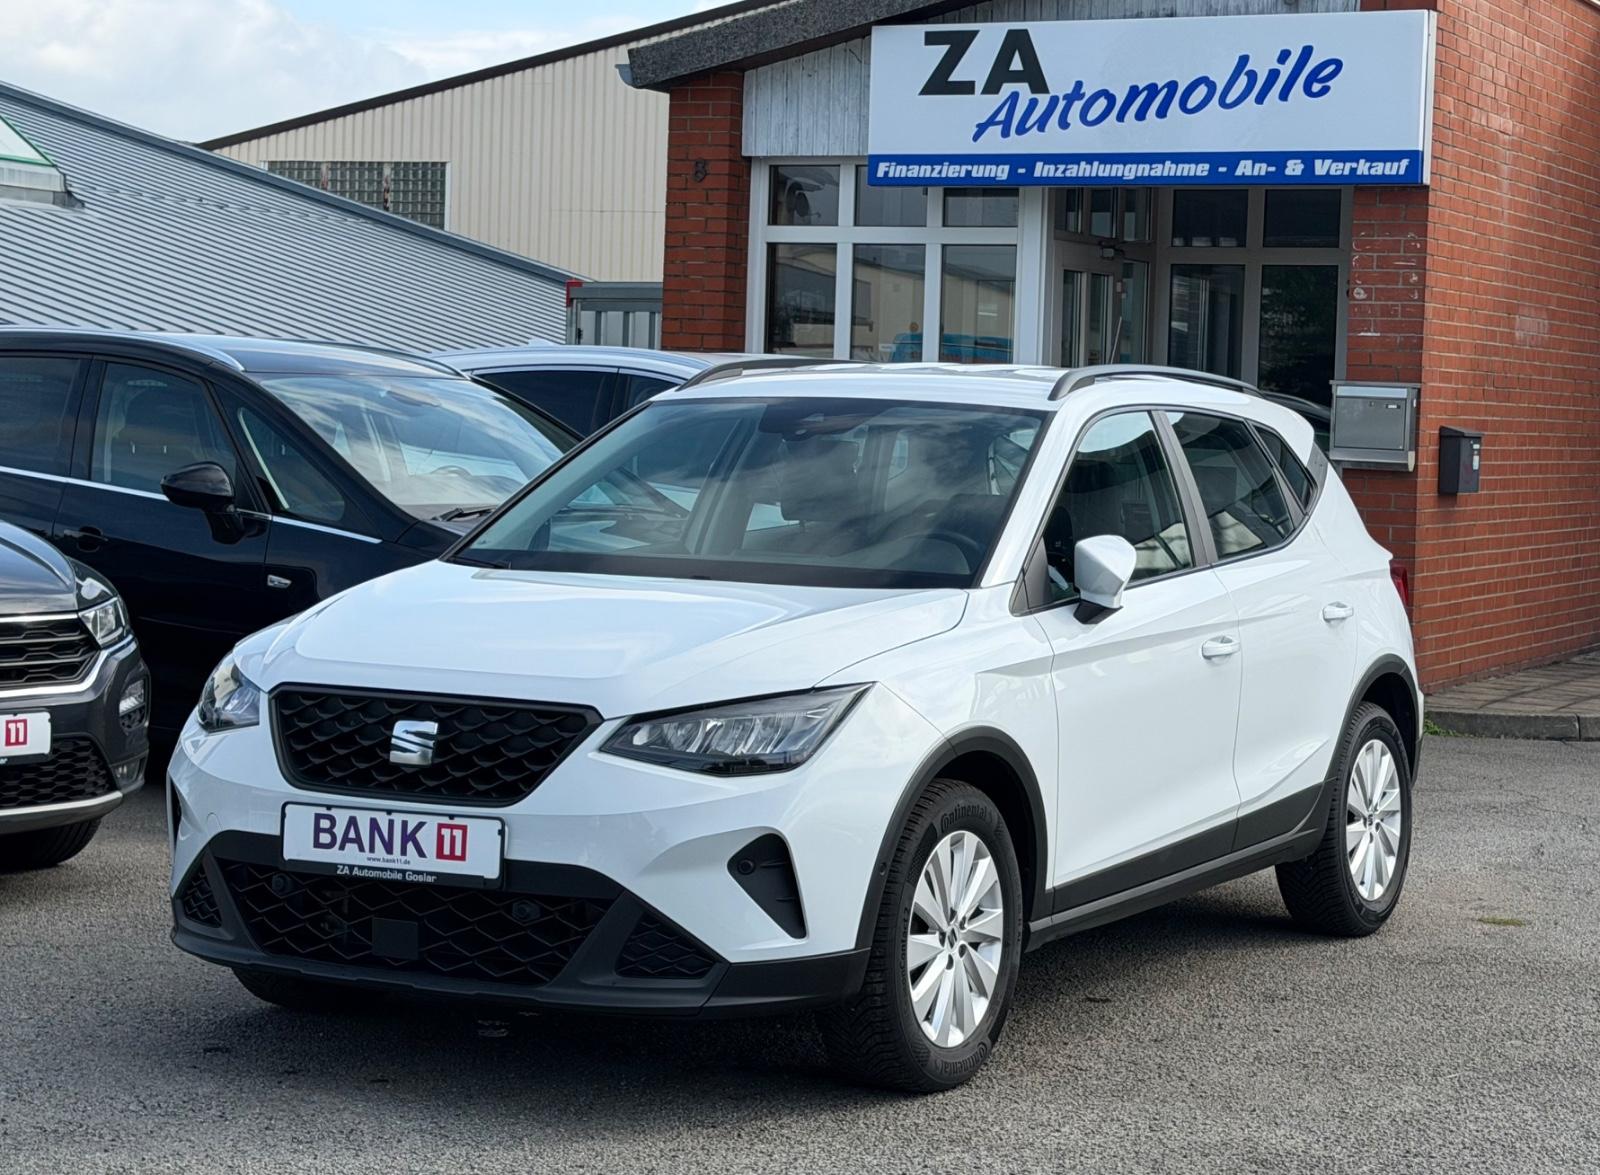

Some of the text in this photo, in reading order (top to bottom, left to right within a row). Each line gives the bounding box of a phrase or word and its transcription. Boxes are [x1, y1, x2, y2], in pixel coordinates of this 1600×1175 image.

[919, 29, 1050, 96] ZA
[972, 45, 1343, 142] Automobile
[876, 161, 1010, 180] Finanzierung
[1033, 160, 1210, 180] Inzahlungnahme
[1234, 160, 1277, 176] An-
[1284, 160, 1305, 176] &
[1314, 158, 1410, 176] Verkauf
[6, 720, 26, 745] 11
[312, 812, 466, 859] BANK 11
[336, 864, 438, 883] ZA Automobile Goslar
[366, 856, 411, 866] www.bank11.de
